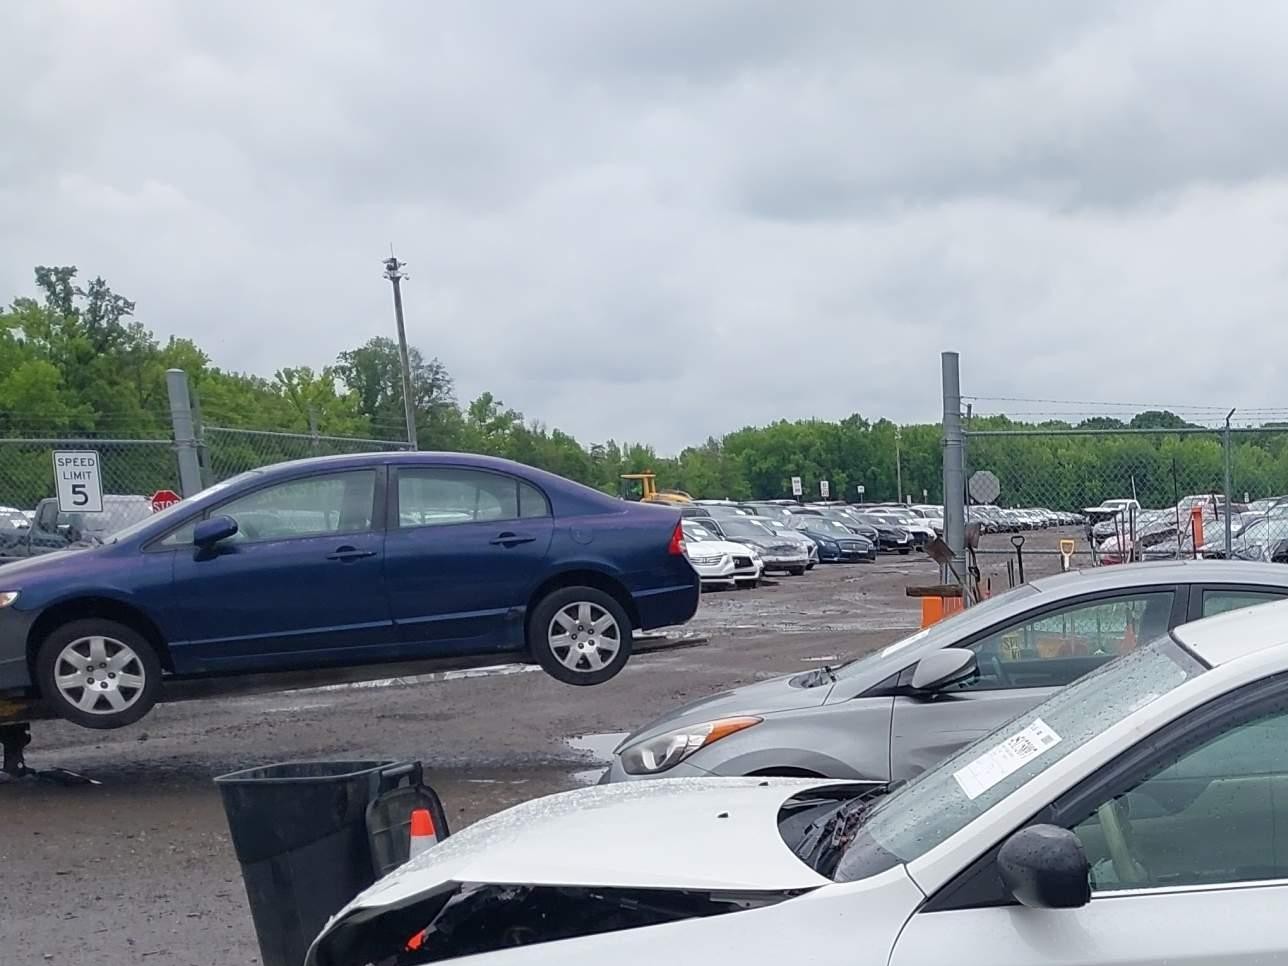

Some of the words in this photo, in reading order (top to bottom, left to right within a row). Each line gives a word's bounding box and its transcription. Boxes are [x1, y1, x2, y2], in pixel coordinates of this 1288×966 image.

[58, 457, 95, 467] SPEED
[63, 471, 93, 480] LIMIT
[71, 483, 89, 506] 5
